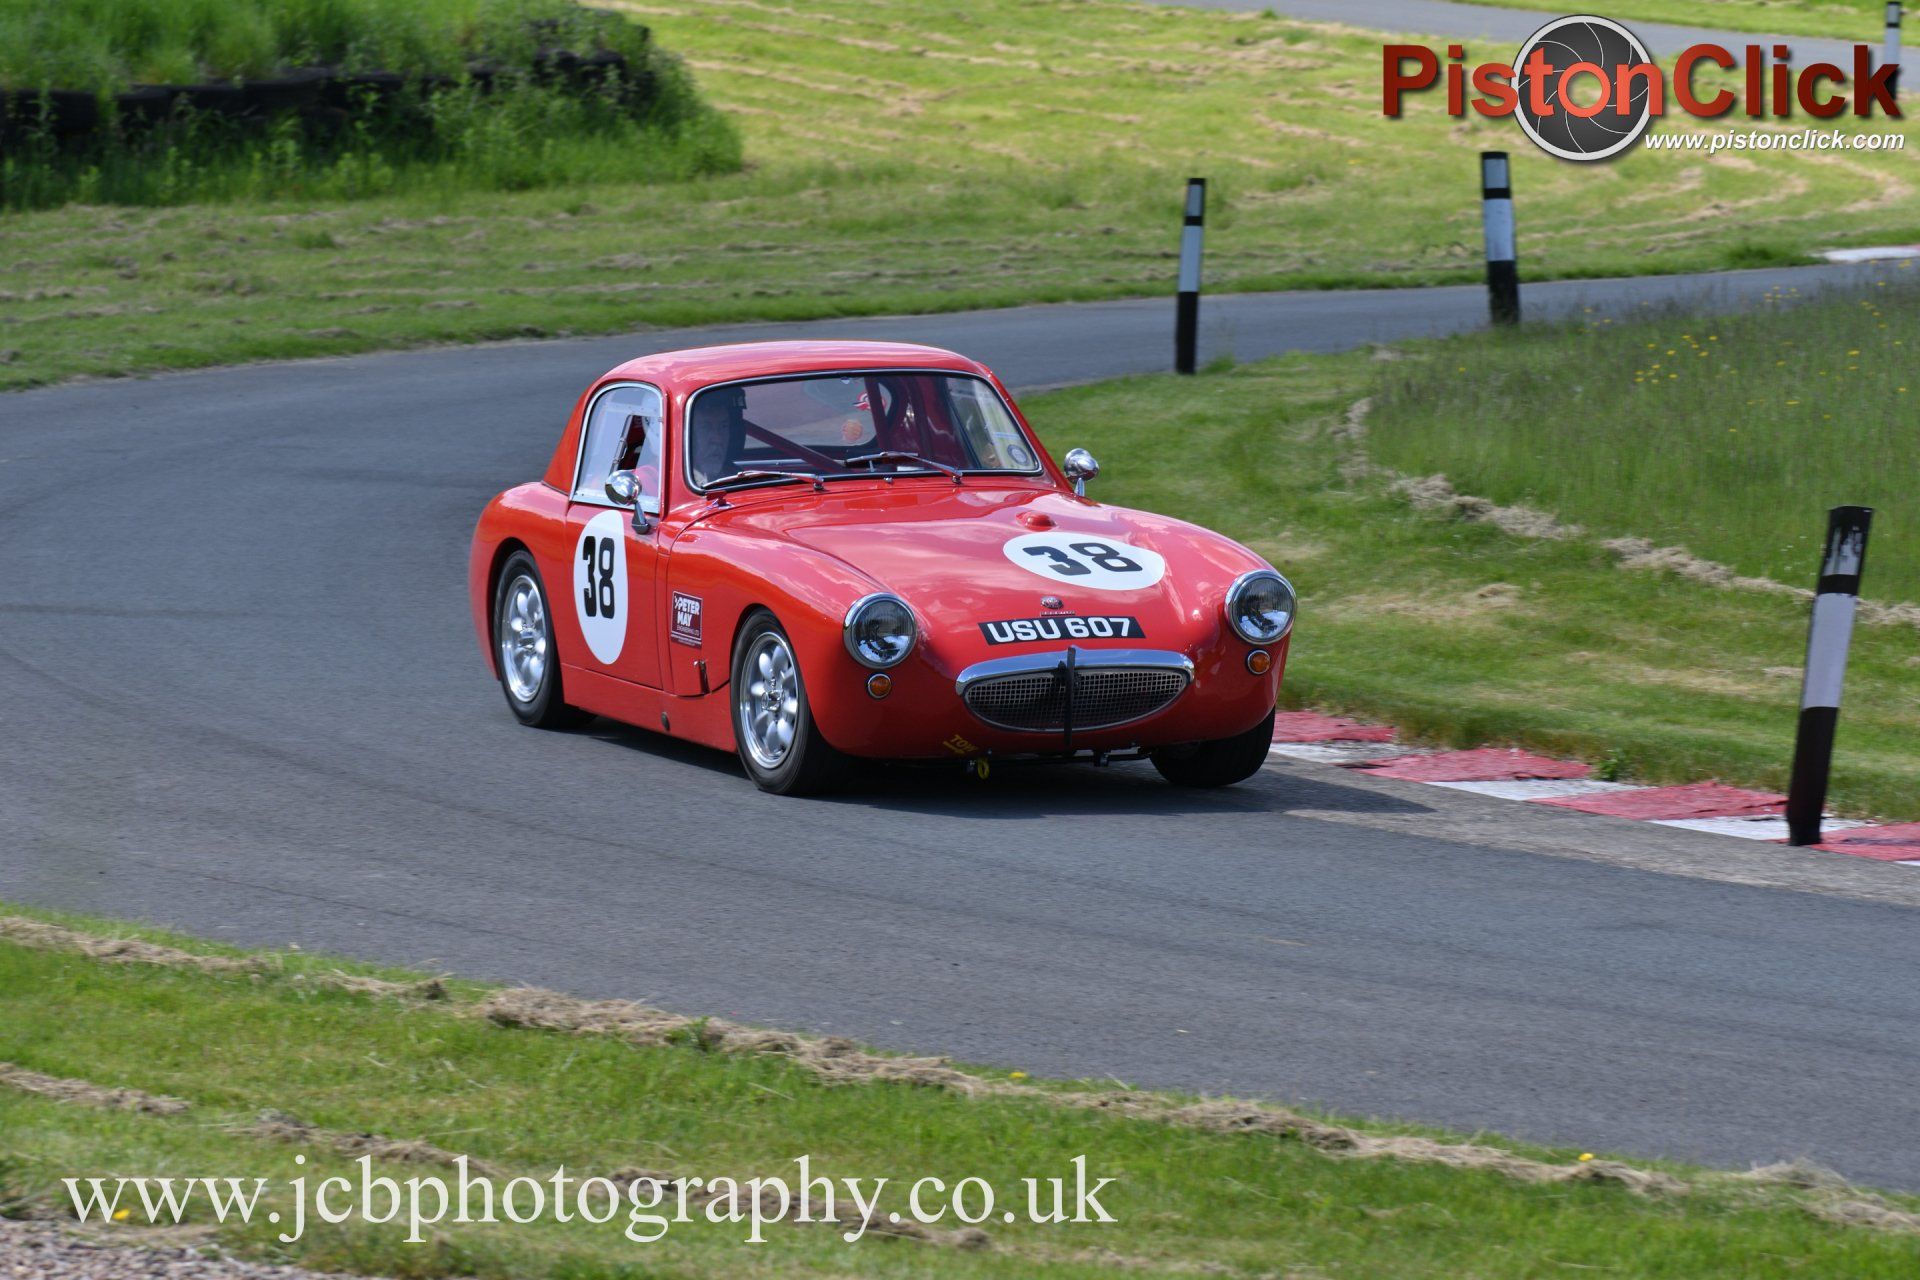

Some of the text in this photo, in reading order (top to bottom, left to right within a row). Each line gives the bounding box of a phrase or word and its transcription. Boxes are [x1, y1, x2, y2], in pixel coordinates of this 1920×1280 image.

[1022, 542, 1143, 576] 38
[583, 535, 615, 619] 38
[677, 597, 700, 616] PETER
[677, 611, 692, 627] MAY
[987, 617, 1130, 643] USU 607
